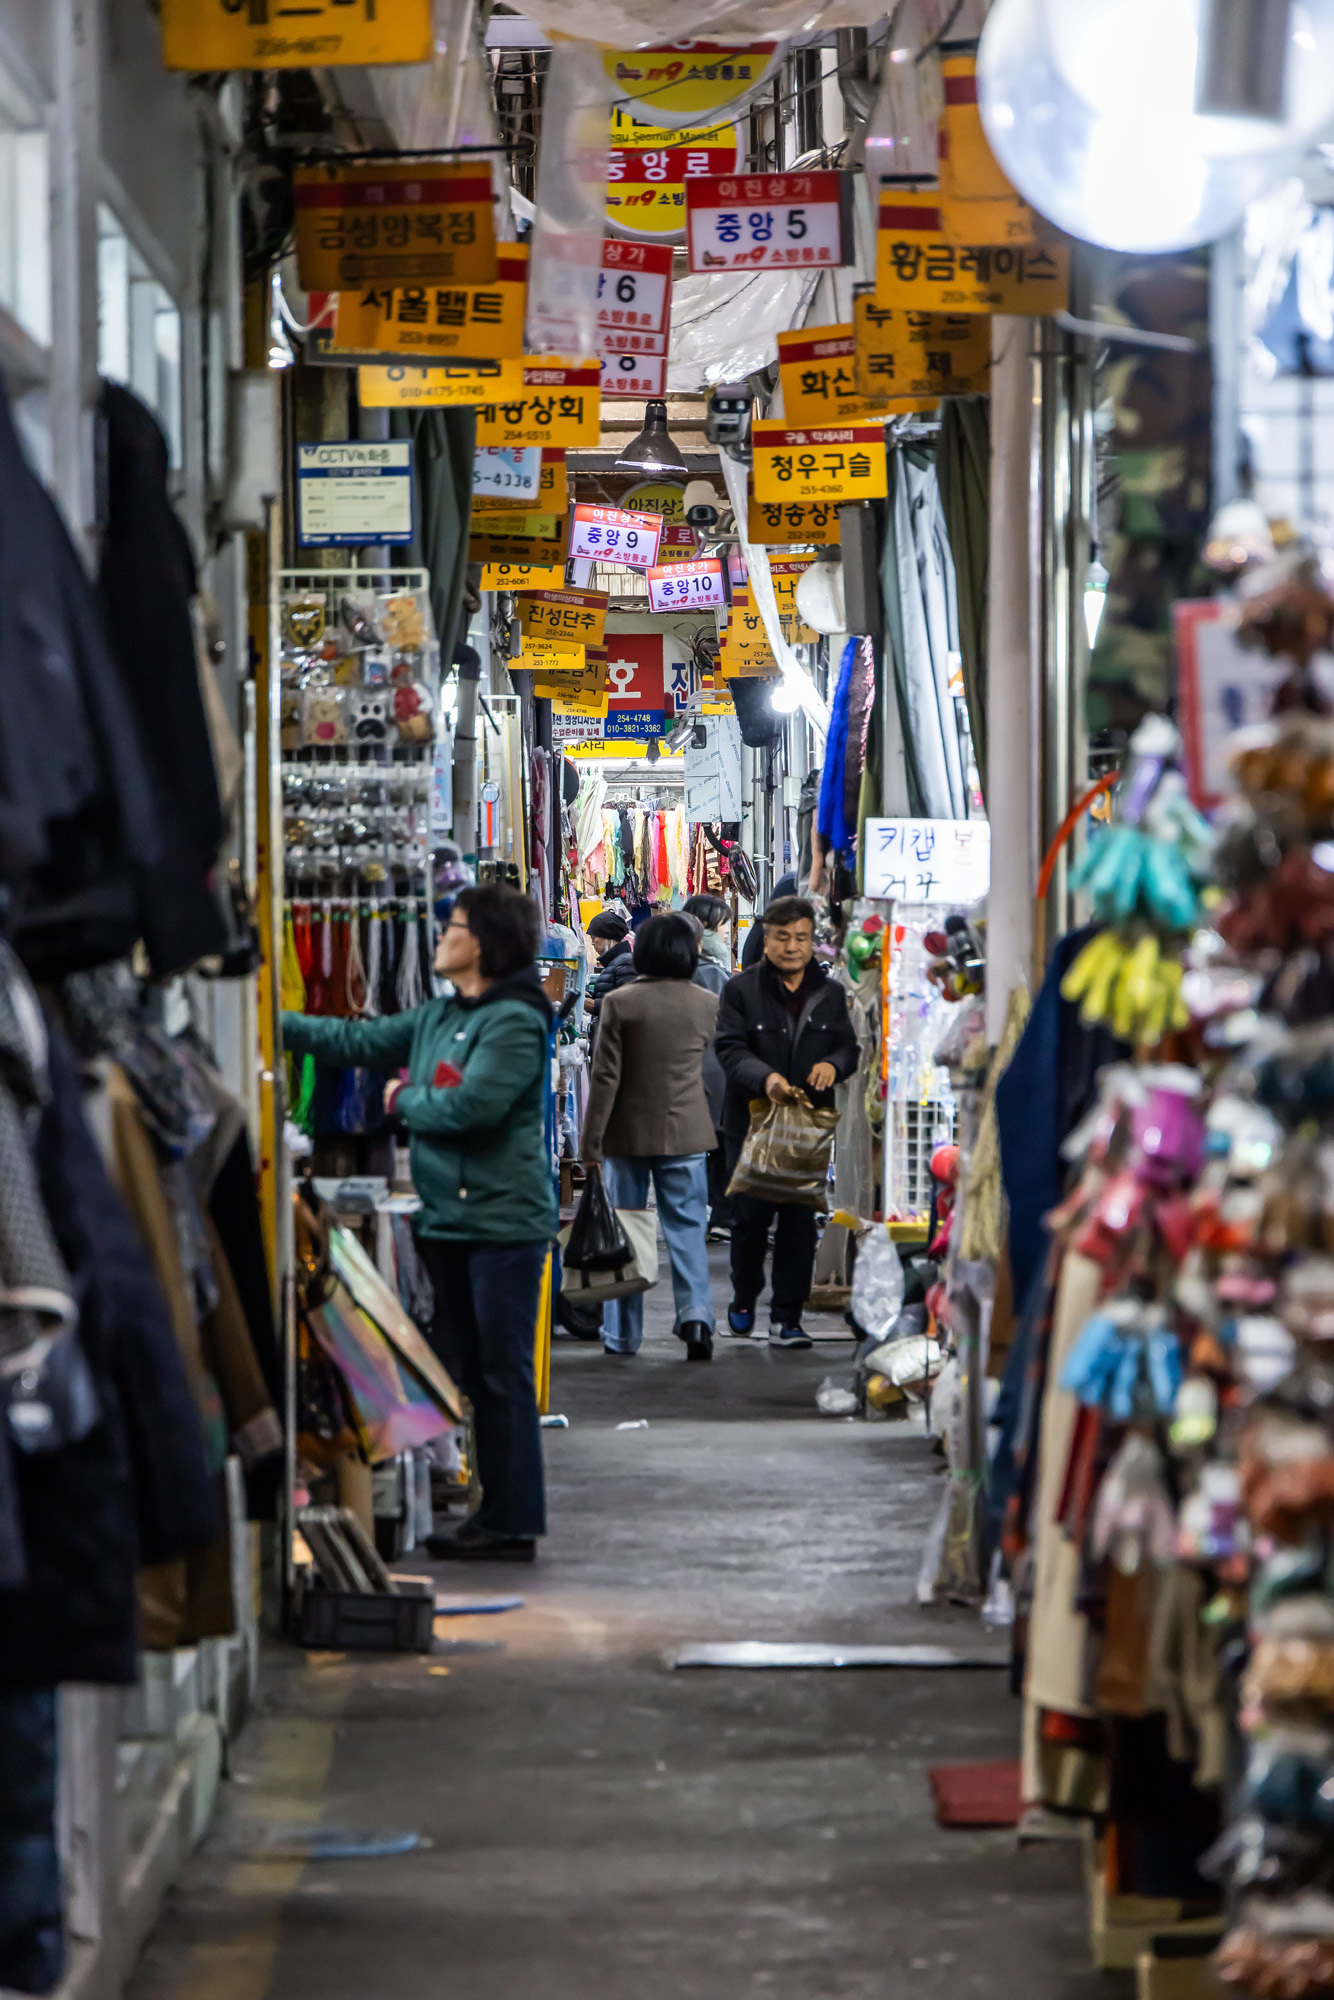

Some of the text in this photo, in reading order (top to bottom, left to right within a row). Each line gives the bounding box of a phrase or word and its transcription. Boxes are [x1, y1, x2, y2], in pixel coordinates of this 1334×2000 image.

[645, 61, 752, 80] 119 소방통로
[633, 131, 676, 142] Seomun
[680, 131, 719, 142] Market
[718, 178, 812, 198] 아진상가
[625, 190, 684, 206] 119 소방
[316, 211, 476, 250] 금성양복점
[715, 209, 808, 242] 중앙 5
[605, 243, 646, 264] 상가
[732, 245, 831, 265] 119 소방통로
[890, 241, 1058, 283] 황금레이스
[616, 275, 637, 303] 6
[597, 308, 653, 326] 소방통로
[603, 335, 656, 350] 소방통로
[603, 378, 653, 392] 소방통로
[771, 452, 871, 482] 청우구슬
[593, 509, 645, 526] 아진상가
[587, 526, 639, 549] 중앙 9
[614, 552, 648, 563] 소방통로
[660, 549, 690, 558] 소방통로
[662, 561, 709, 574] 아진상가
[496, 578, 530, 586] 252-6061
[662, 576, 712, 596] 중앙 10
[690, 593, 719, 604] 소방통로
[782, 602, 798, 610] 253-
[528, 605, 596, 630] 진성단추
[545, 628, 574, 637] 252-2344
[617, 714, 651, 723] 254-4748
[553, 727, 599, 736] 수업준비물 일체
[607, 724, 661, 733] 010-3821-3362
[732, 743, 740, 762] posco
[725, 780, 734, 799] posco
[877, 826, 935, 862] 키캡
